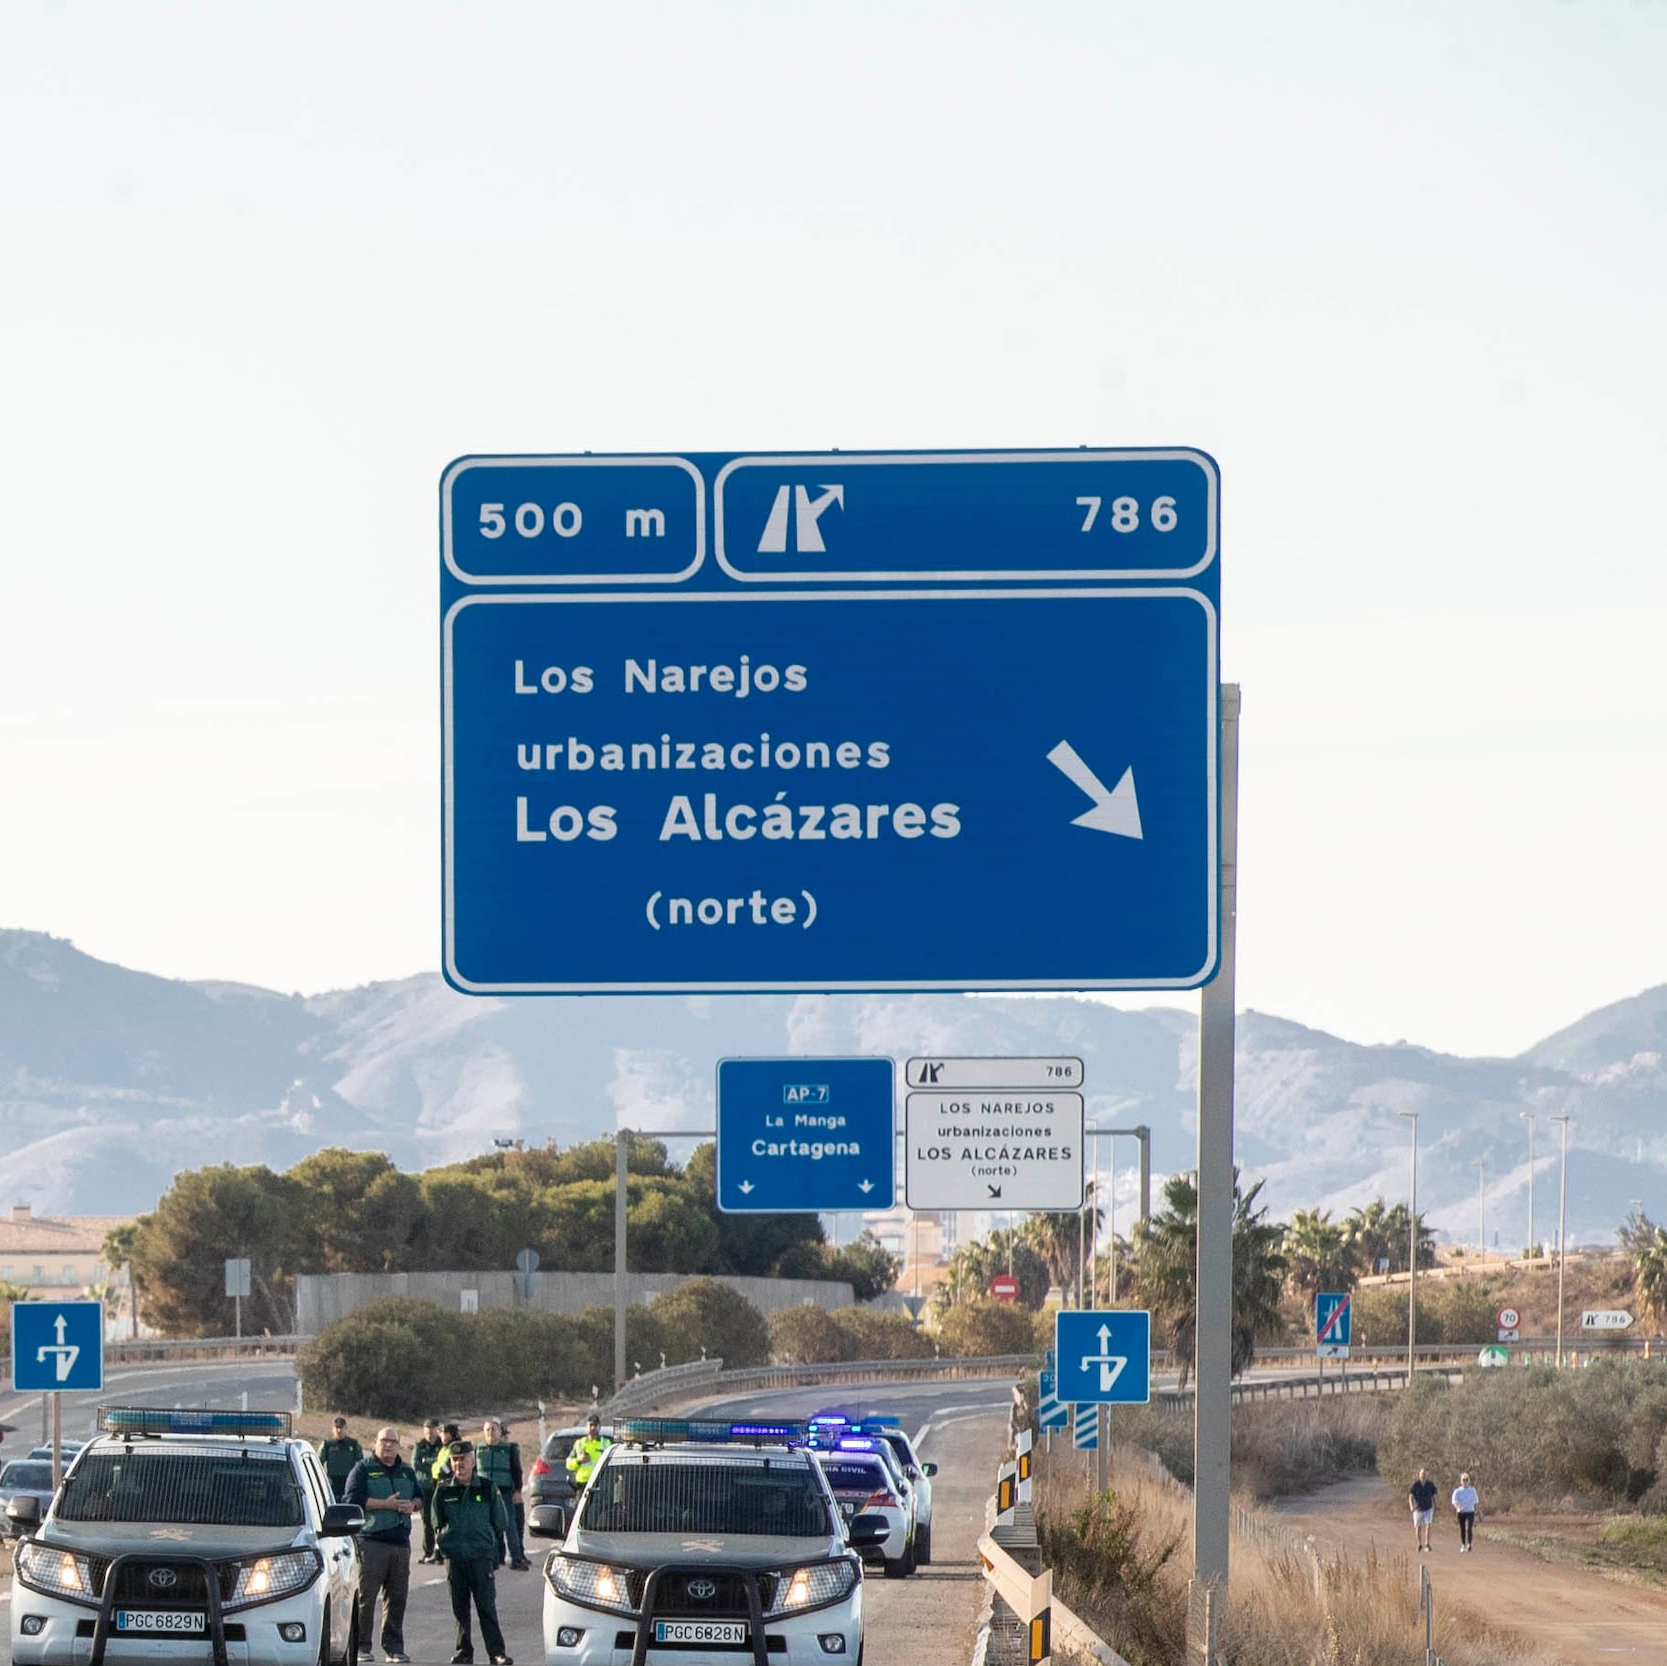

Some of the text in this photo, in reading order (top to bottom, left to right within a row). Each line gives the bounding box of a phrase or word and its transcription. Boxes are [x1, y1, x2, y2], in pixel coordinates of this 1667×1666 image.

[479, 502, 665, 539] 500 m
[1076, 495, 1178, 533] 786
[514, 654, 808, 698] Los Narejos
[517, 732, 891, 771] urbanizaciones
[516, 791, 961, 842] Los Alcázares
[646, 889, 818, 930] (norte)
[1046, 1066, 1072, 1078] 786
[787, 1086, 828, 1101] AP-7
[940, 1102, 1055, 1115] LOS NAREJOS
[765, 1114, 846, 1130] La Manga
[938, 1125, 1052, 1137] urbanizaciones
[751, 1139, 860, 1160] Cartagena
[917, 1143, 1072, 1161] LOS ALCÁZARES
[971, 1165, 1018, 1177] (norte)
[1503, 1313, 1516, 1323] 70
